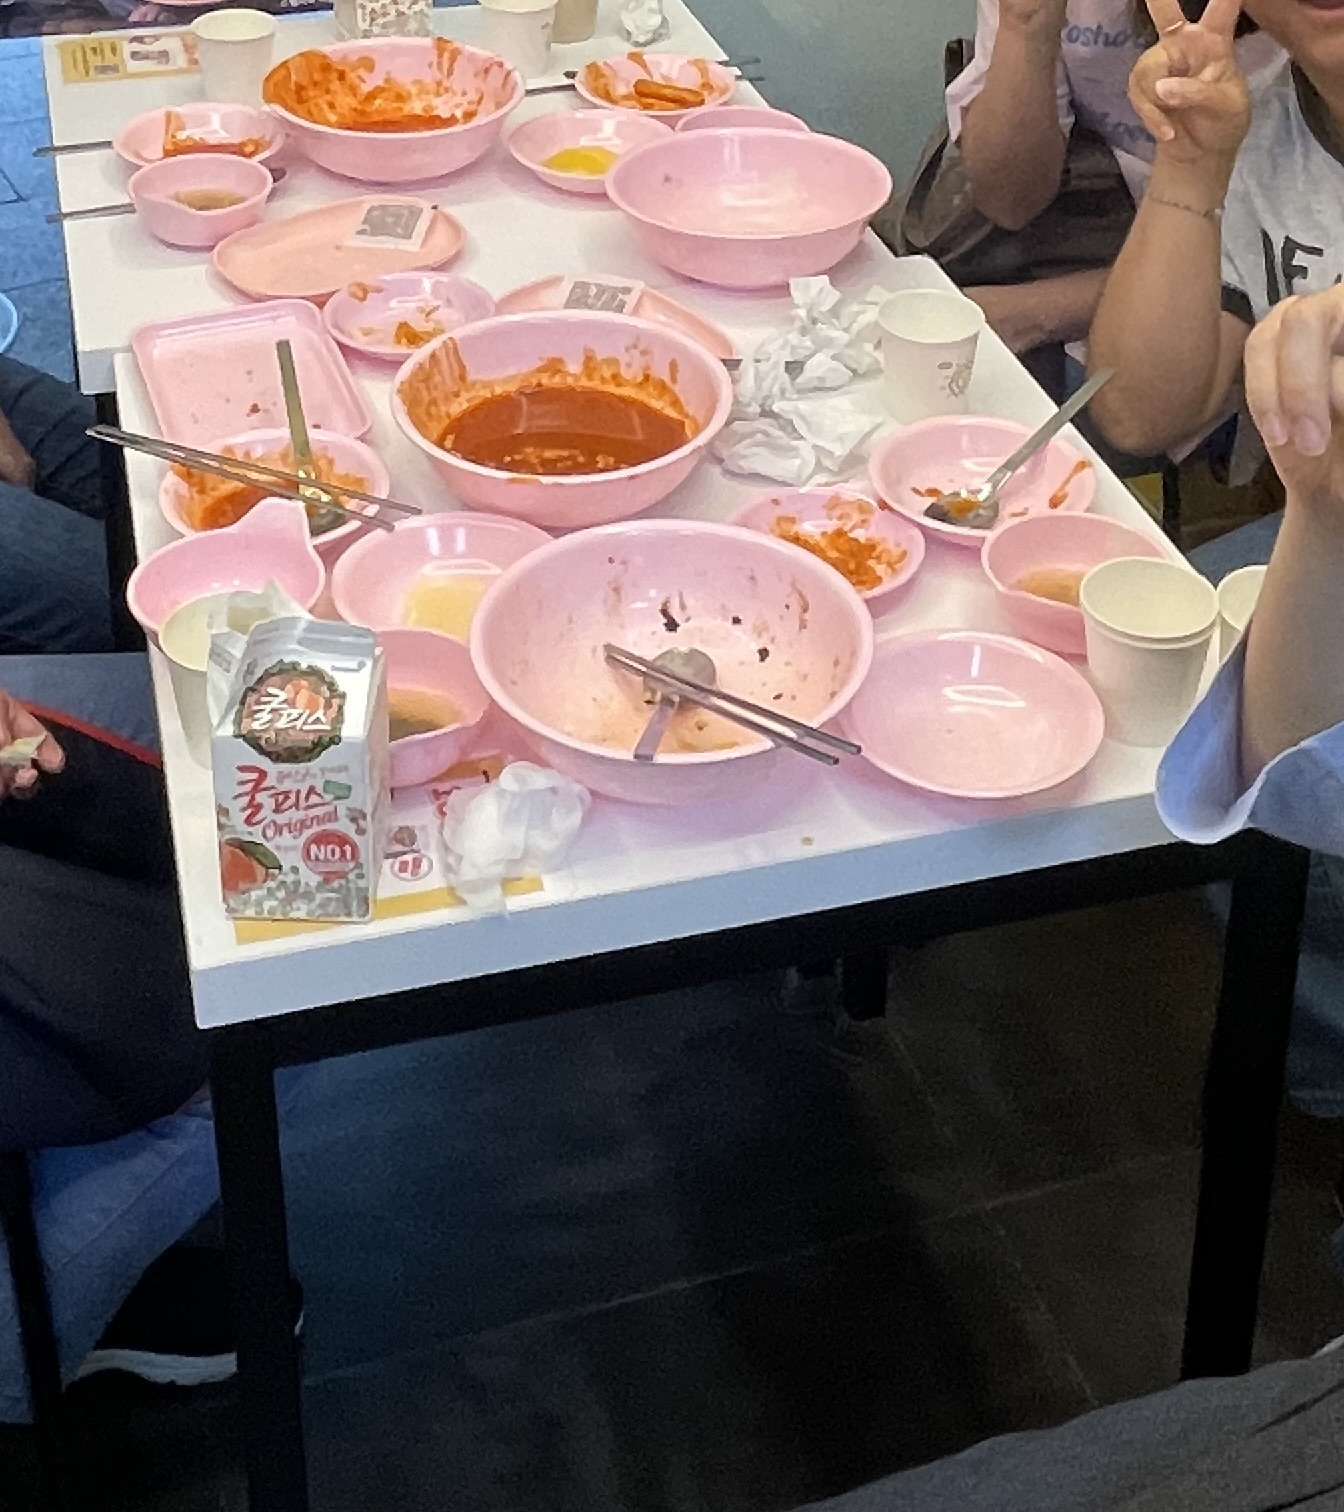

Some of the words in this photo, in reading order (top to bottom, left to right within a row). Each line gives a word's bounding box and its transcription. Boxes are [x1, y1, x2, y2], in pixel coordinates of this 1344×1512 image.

[250, 686, 332, 731] 쿨피스
[231, 764, 334, 827] 쿨피스
[260, 805, 340, 843] Original
